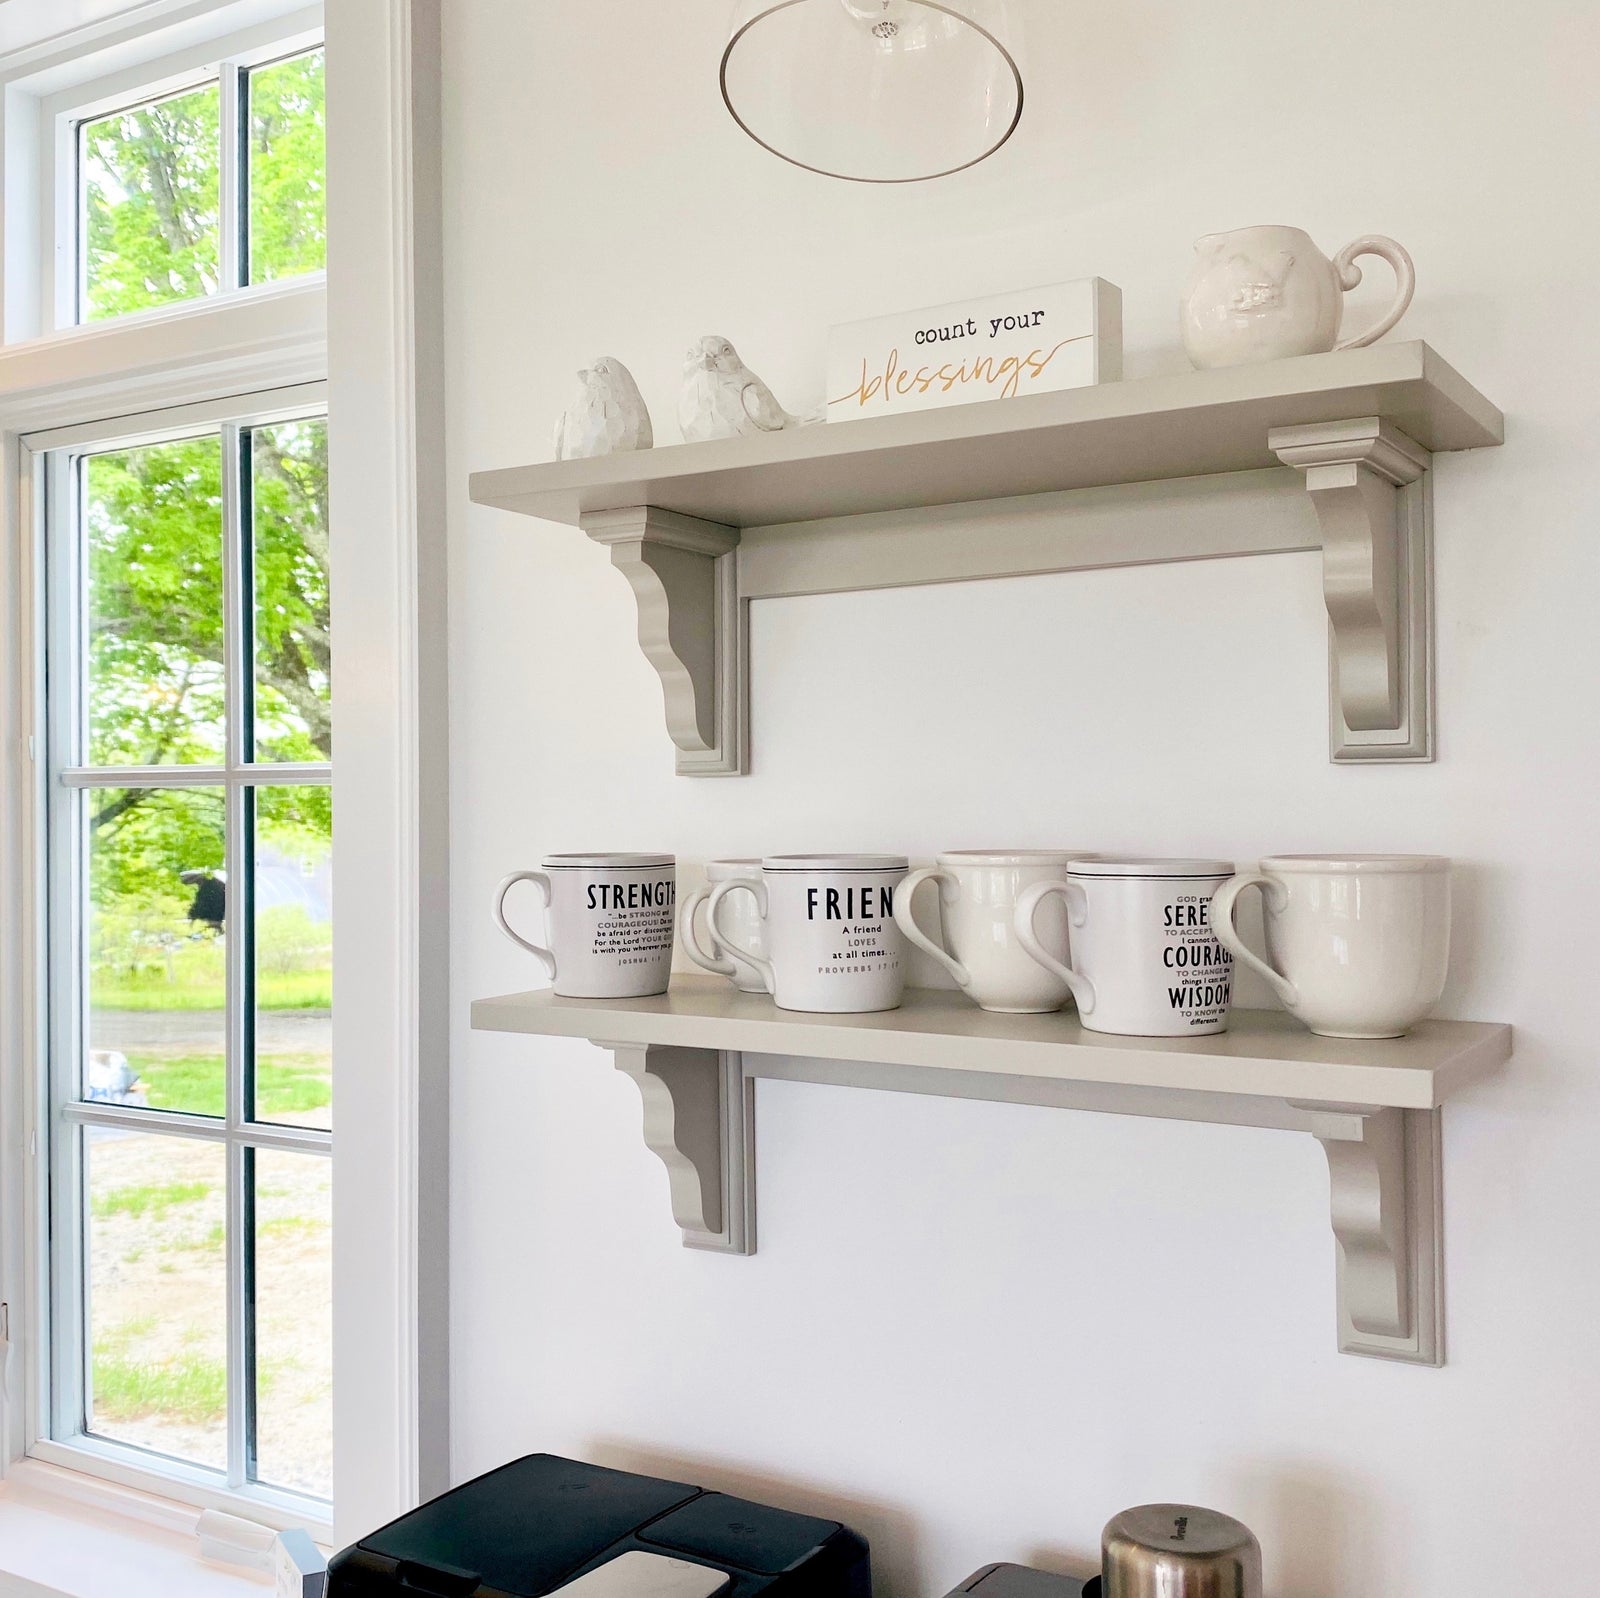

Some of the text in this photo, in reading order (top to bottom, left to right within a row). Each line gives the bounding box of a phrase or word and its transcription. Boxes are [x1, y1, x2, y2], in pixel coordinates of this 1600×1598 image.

[914, 310, 1045, 345] count your
[828, 335, 1093, 407] blessings
[629, 911, 661, 919] STRONG
[842, 925, 882, 934] A friend
[1179, 928, 1213, 936] ACCEPT
[623, 937, 640, 945] Lord
[848, 938, 877, 947] LOVES
[618, 946, 631, 954] you
[633, 943, 660, 952] wherever
[846, 951, 858, 959] all
[618, 957, 648, 966] JOSHUA
[818, 965, 872, 974] PROVERBS
[1191, 968, 1223, 977] CHANGE
[1181, 977, 1202, 986] things
[1194, 1009, 1218, 1017] KNOW
